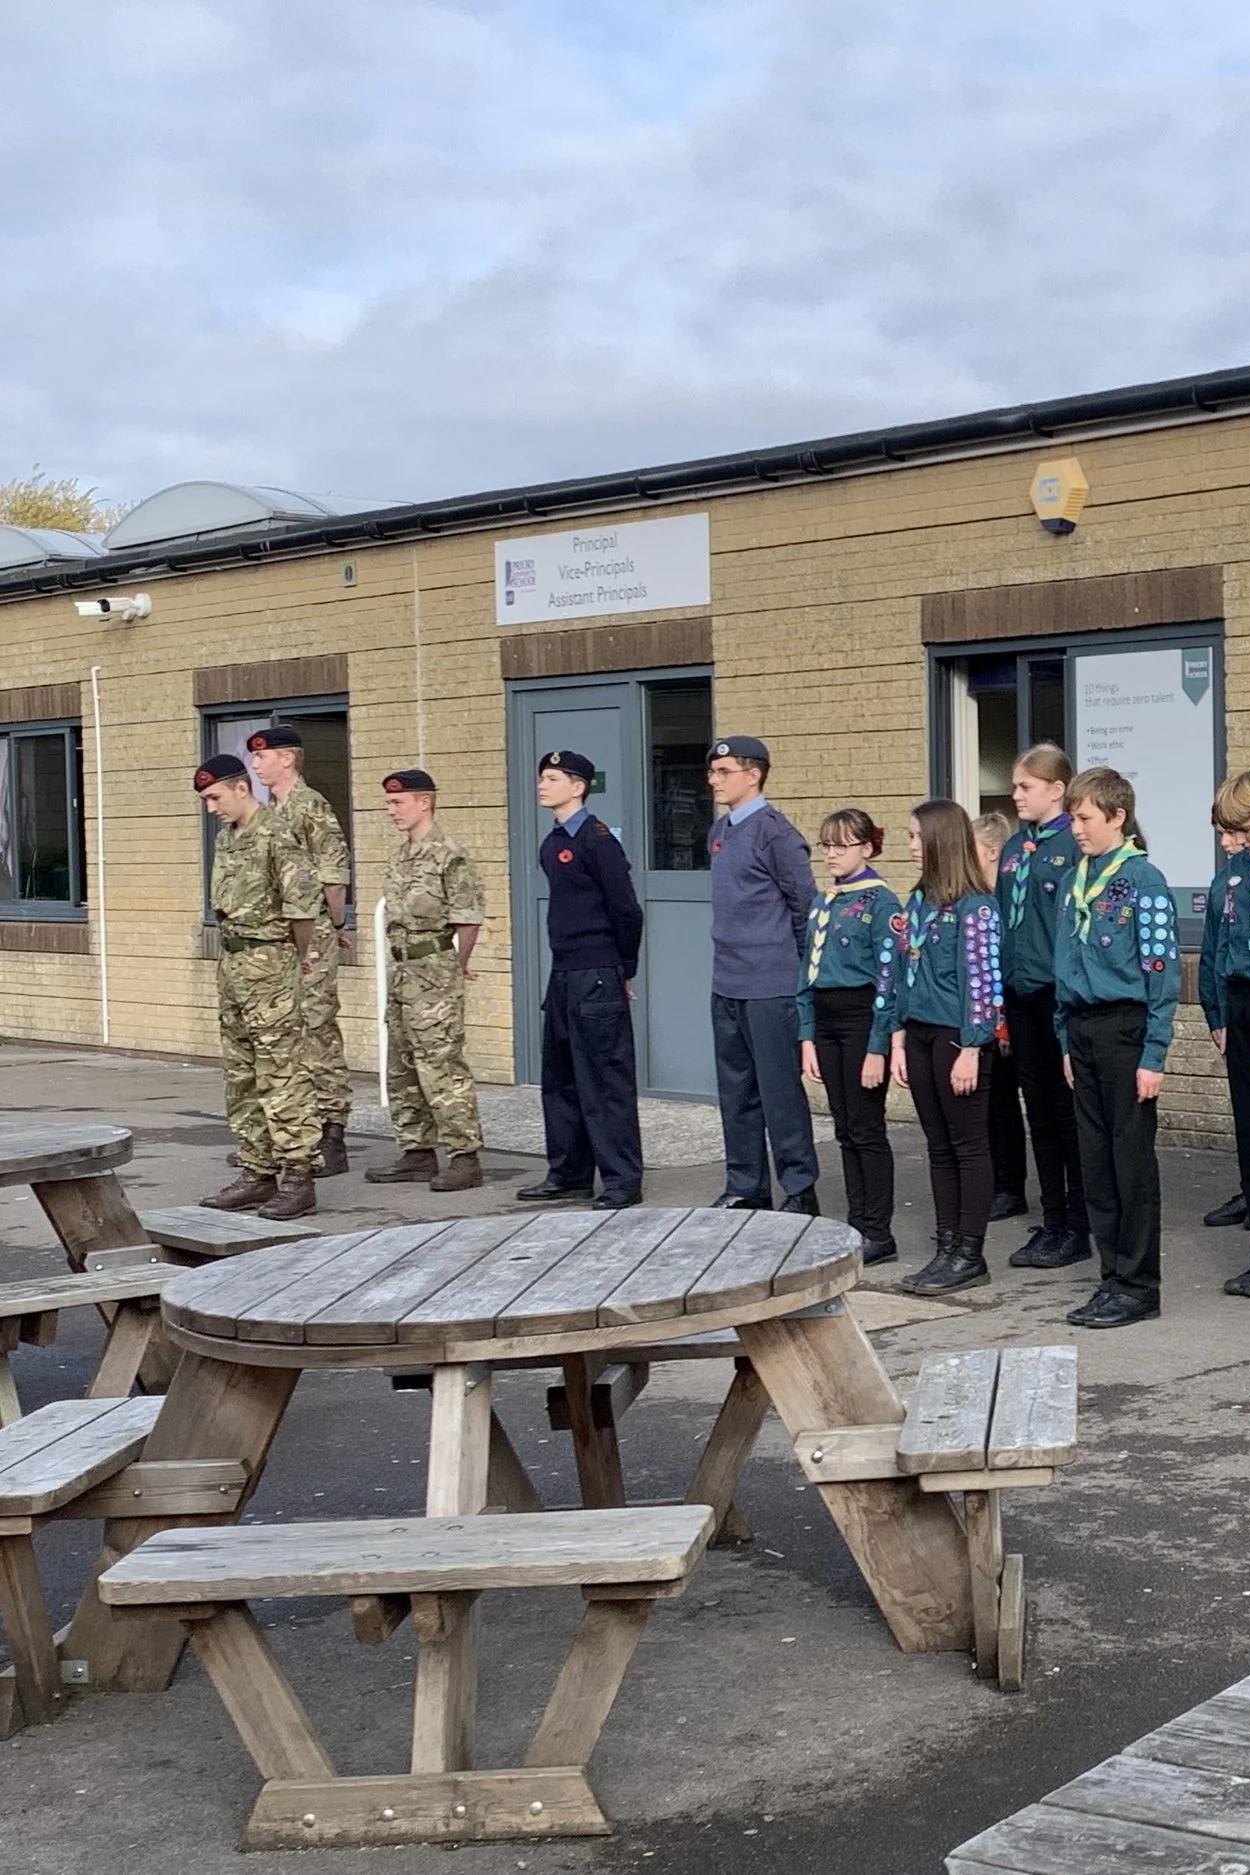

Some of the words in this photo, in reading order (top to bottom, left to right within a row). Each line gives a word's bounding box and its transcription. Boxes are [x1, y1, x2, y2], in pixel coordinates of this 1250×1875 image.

[573, 531, 617, 554] Principal
[558, 556, 635, 580] Vice-Principals
[548, 591, 594, 608] Assistant
[597, 581, 648, 605] Principals
[1103, 696, 1131, 707] require
